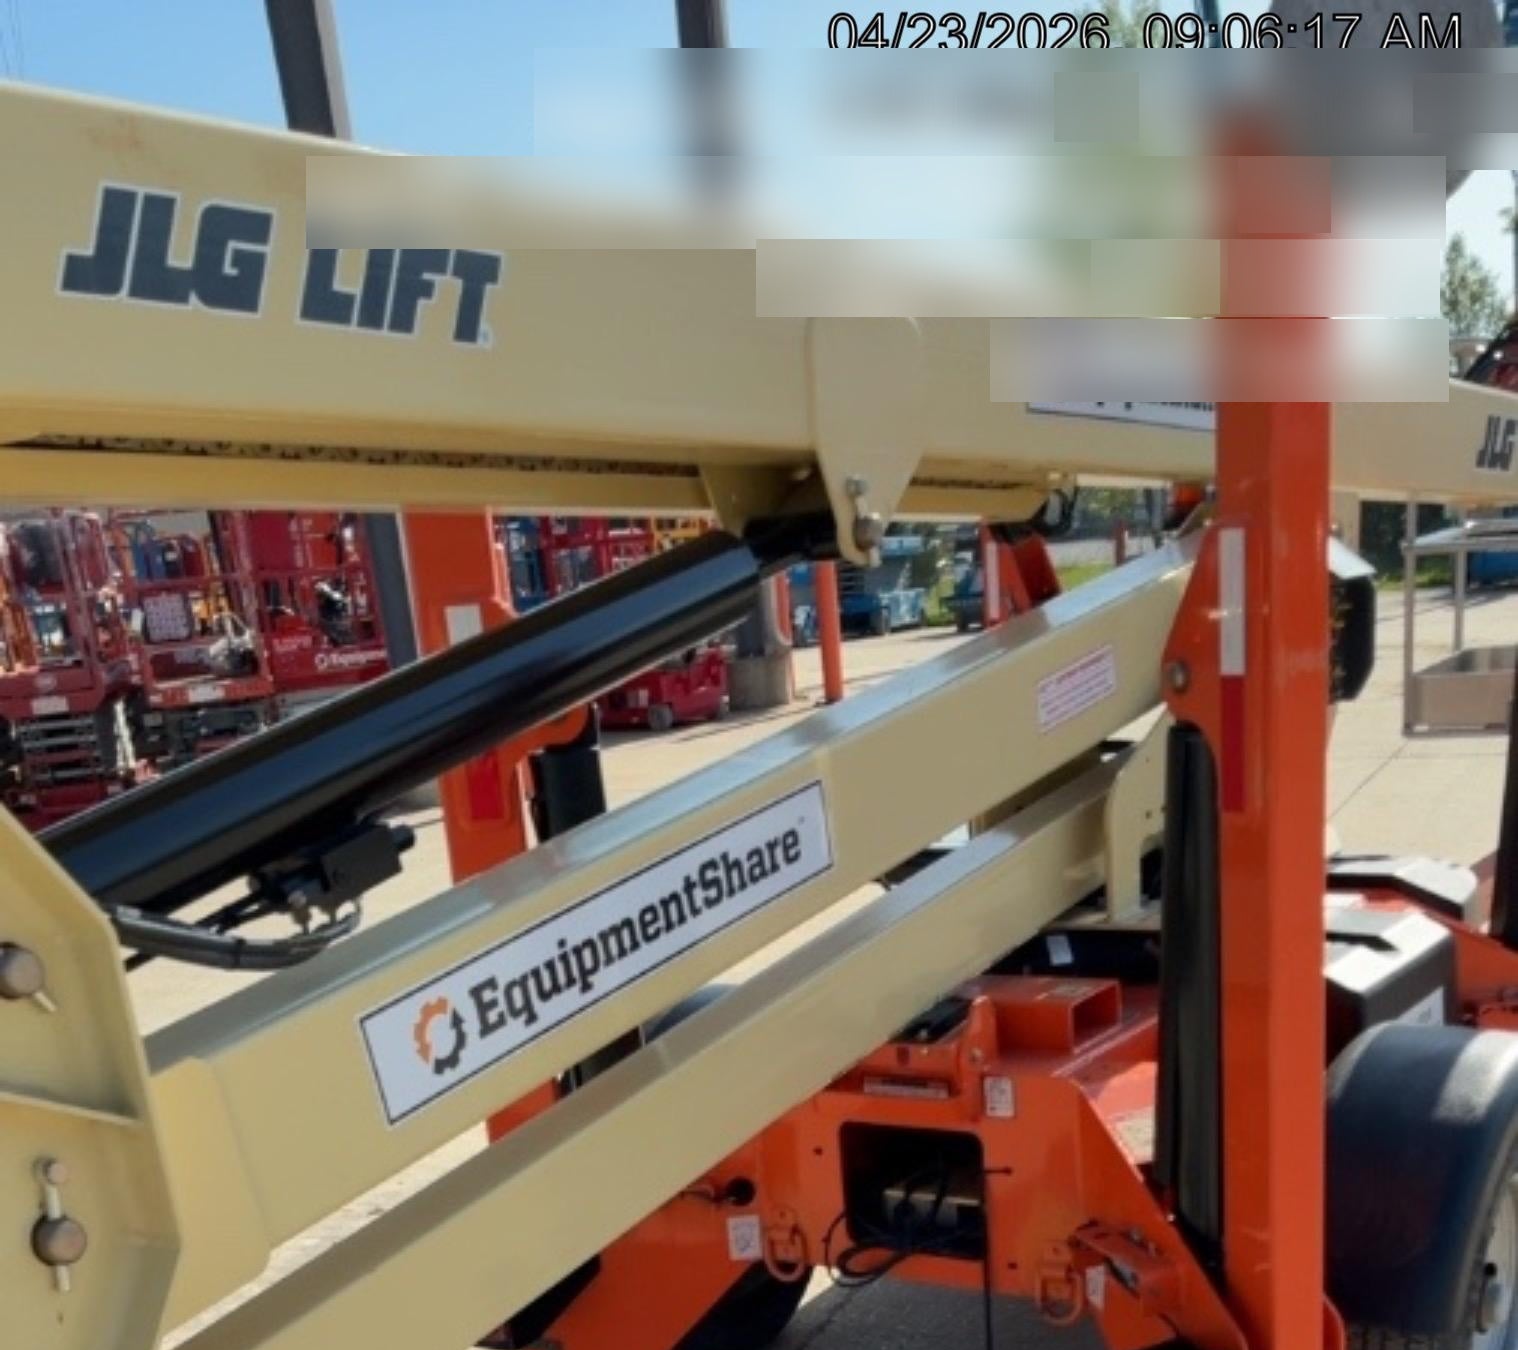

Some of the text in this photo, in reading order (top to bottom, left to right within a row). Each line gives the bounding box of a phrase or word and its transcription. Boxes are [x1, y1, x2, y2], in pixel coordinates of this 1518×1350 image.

[62, 186, 502, 345] JLG LIFT
[468, 827, 801, 1038] EquipmentShare
